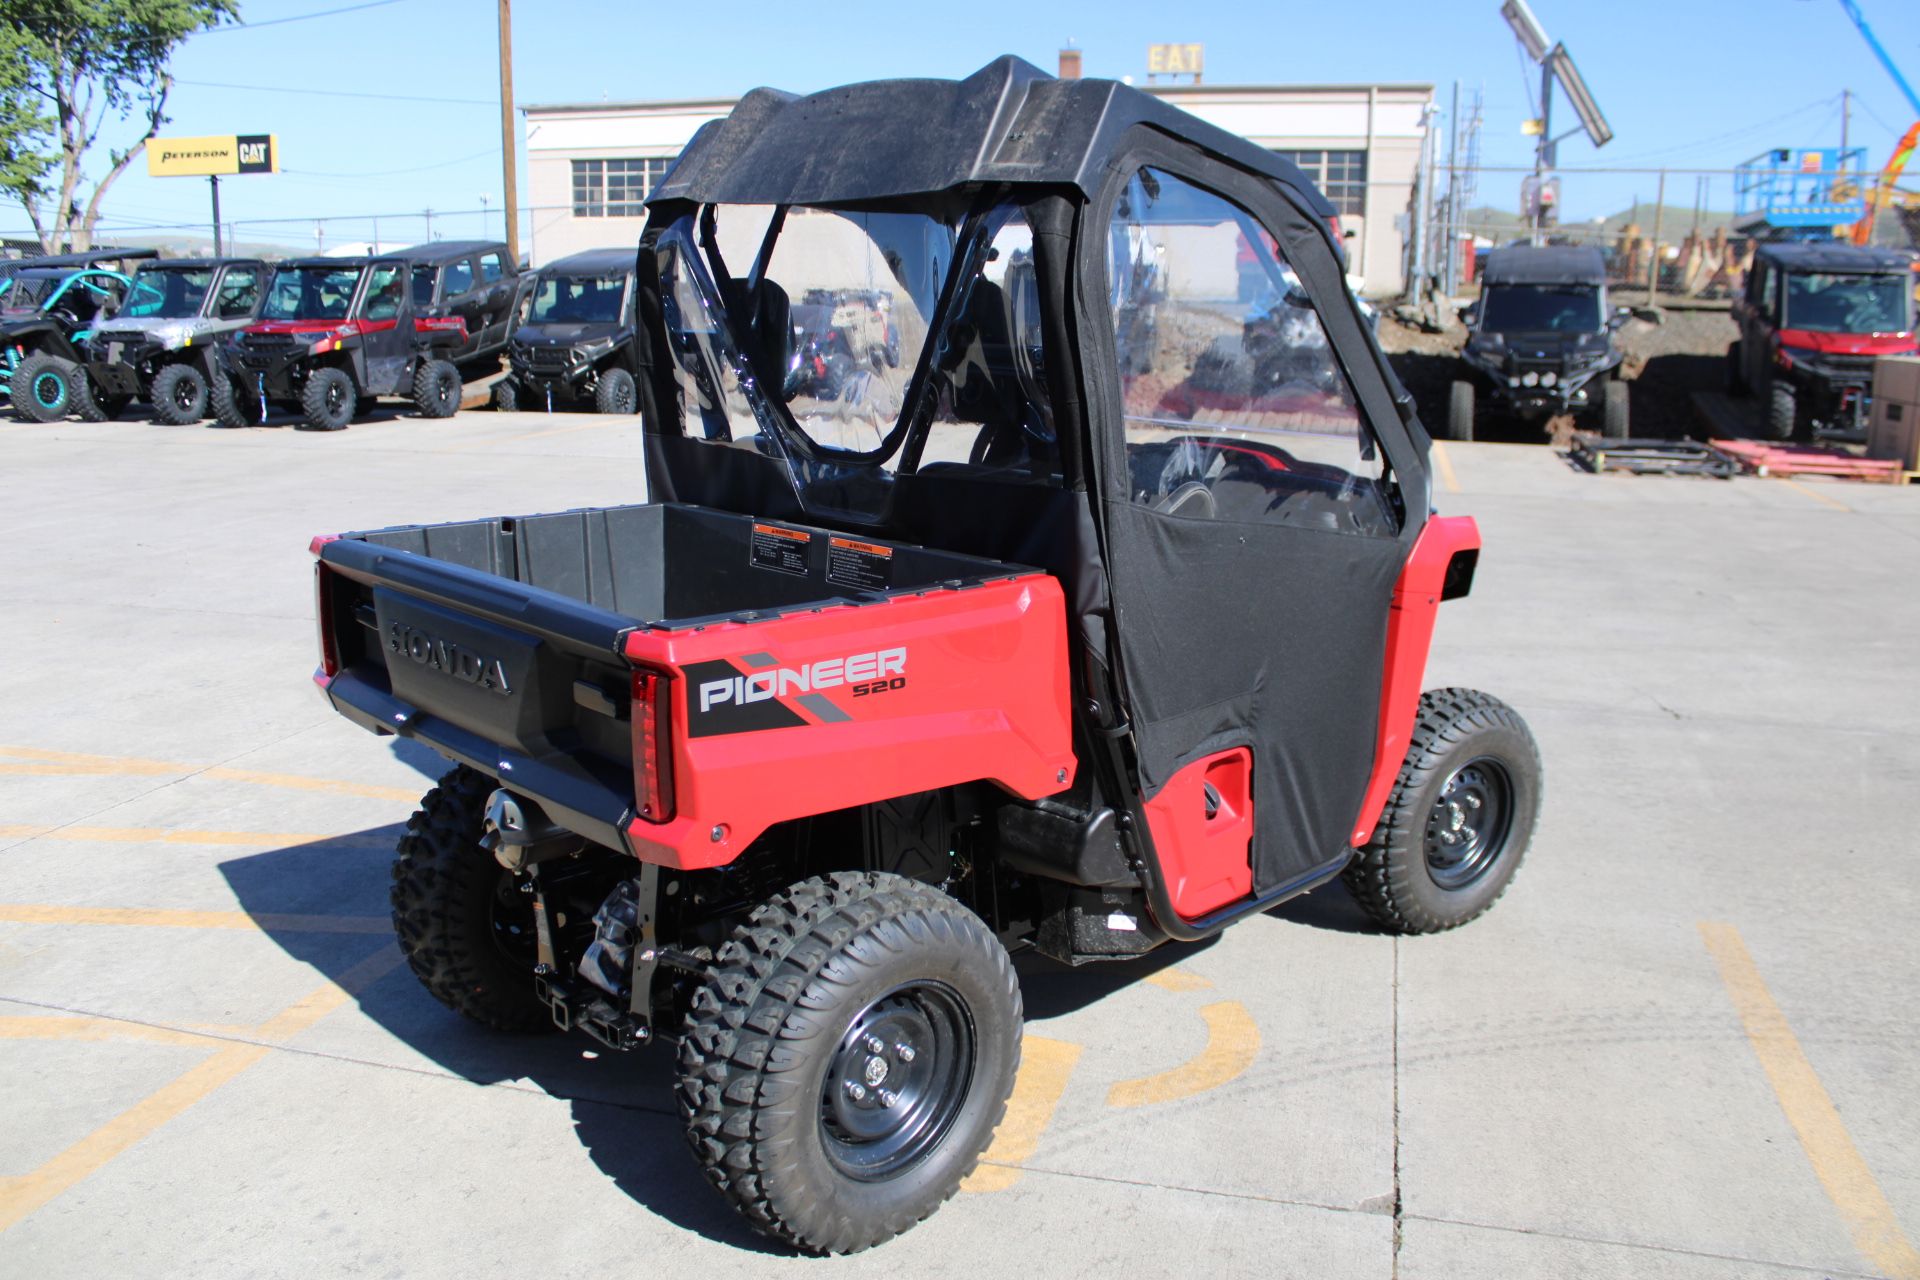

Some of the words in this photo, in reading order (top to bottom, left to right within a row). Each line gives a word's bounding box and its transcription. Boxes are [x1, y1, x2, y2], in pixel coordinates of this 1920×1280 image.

[1149, 44, 1202, 71] EAT
[239, 143, 267, 164] CAT
[391, 622, 513, 696] HONDA
[700, 647, 907, 713] PIONEER
[853, 677, 906, 698] 520
